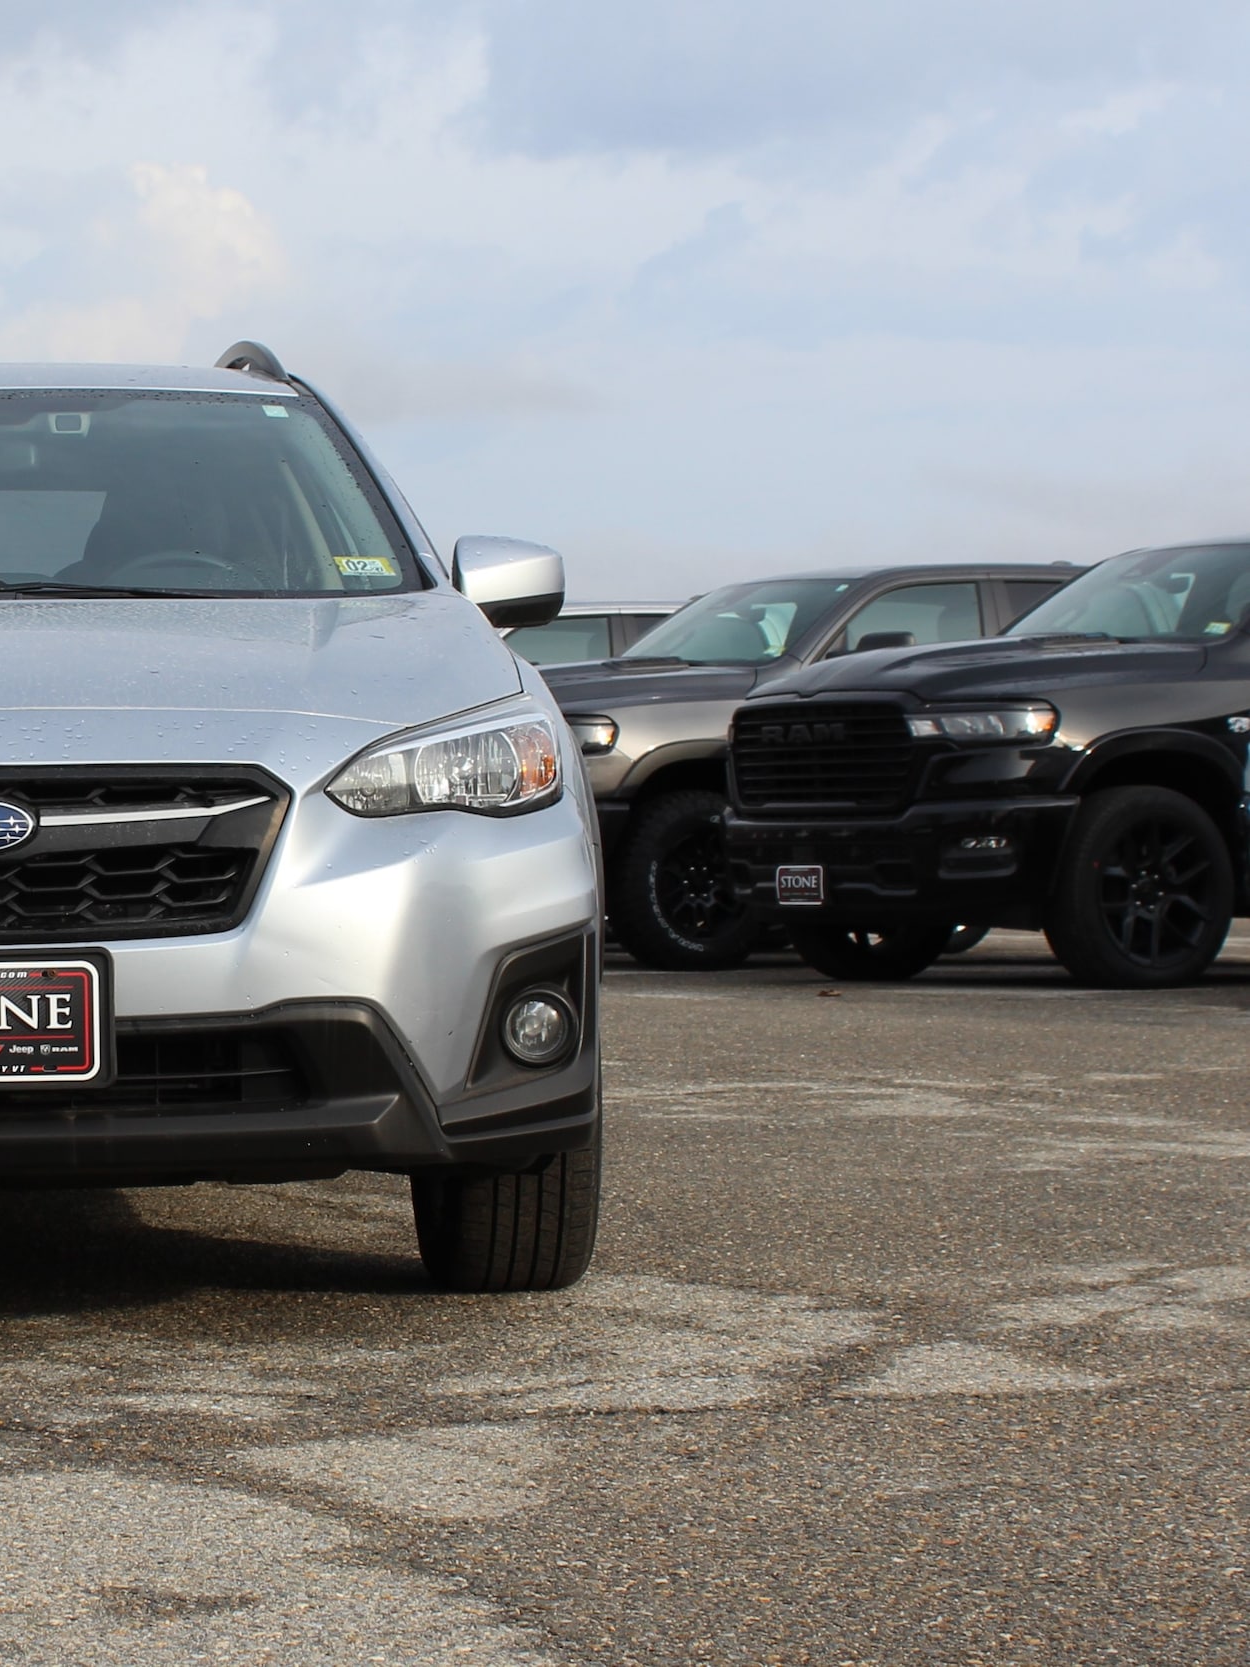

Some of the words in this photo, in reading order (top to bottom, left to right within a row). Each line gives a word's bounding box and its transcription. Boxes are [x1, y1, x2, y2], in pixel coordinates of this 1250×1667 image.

[345, 560, 368, 572] 02
[761, 722, 846, 743] RAM
[780, 875, 818, 889] STONE
[9, 1044, 35, 1055] Jeep
[11, 1065, 27, 1073] VT
